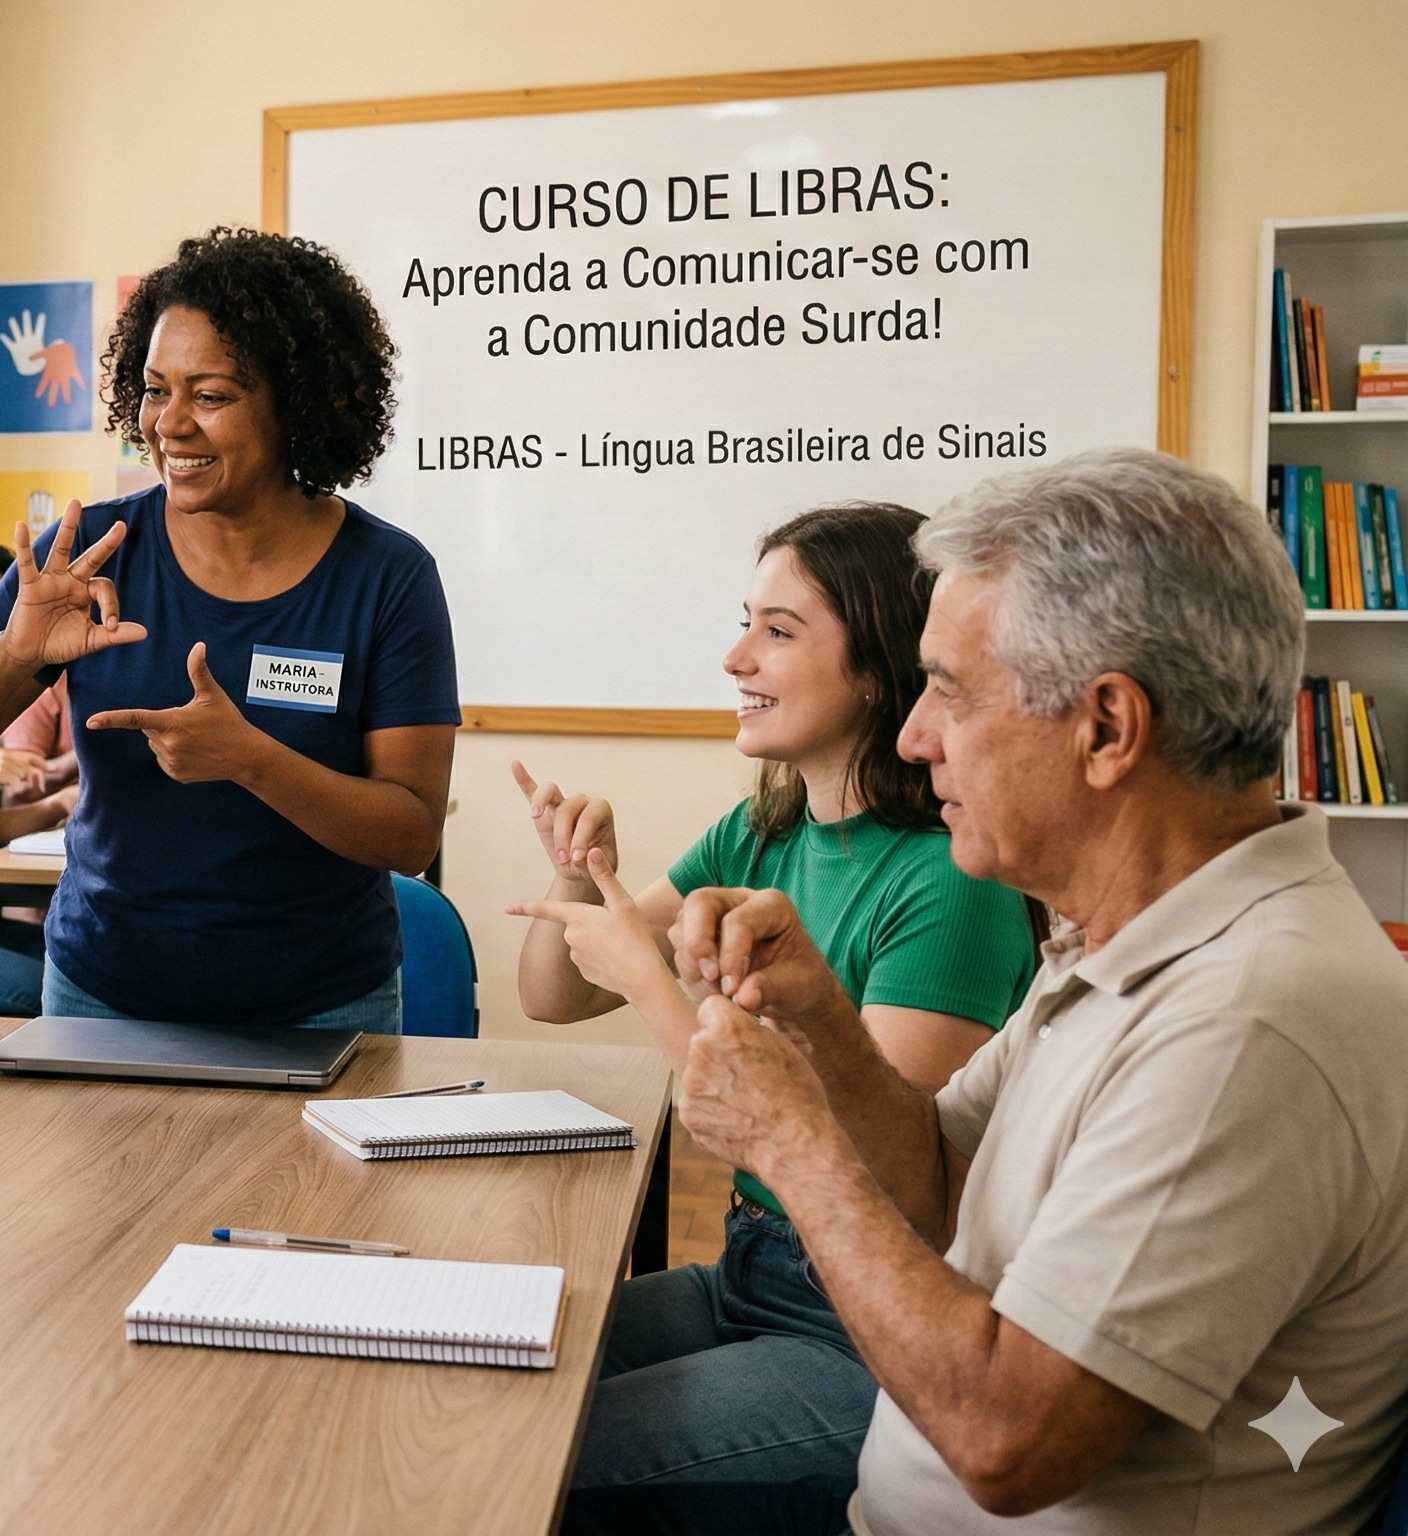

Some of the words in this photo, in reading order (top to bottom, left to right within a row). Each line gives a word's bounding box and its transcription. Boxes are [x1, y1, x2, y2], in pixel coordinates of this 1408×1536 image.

[479, 179, 647, 233] CURSO
[669, 174, 729, 222] DE
[751, 162, 948, 217] LIBRAS:
[403, 253, 571, 306] Aprenda
[586, 259, 607, 289] a
[624, 240, 918, 288] Comunicar-se
[936, 238, 1028, 273] com
[488, 326, 509, 356] a
[525, 306, 784, 355] Comunidade
[802, 298, 940, 344] Surda!
[419, 435, 542, 470] LIBRAS
[582, 432, 694, 473] Língua
[709, 428, 870, 463] Brasileira
[883, 426, 924, 460] de
[939, 423, 1046, 459] Sinais
[256, 678, 334, 697] INSTRUTORA
